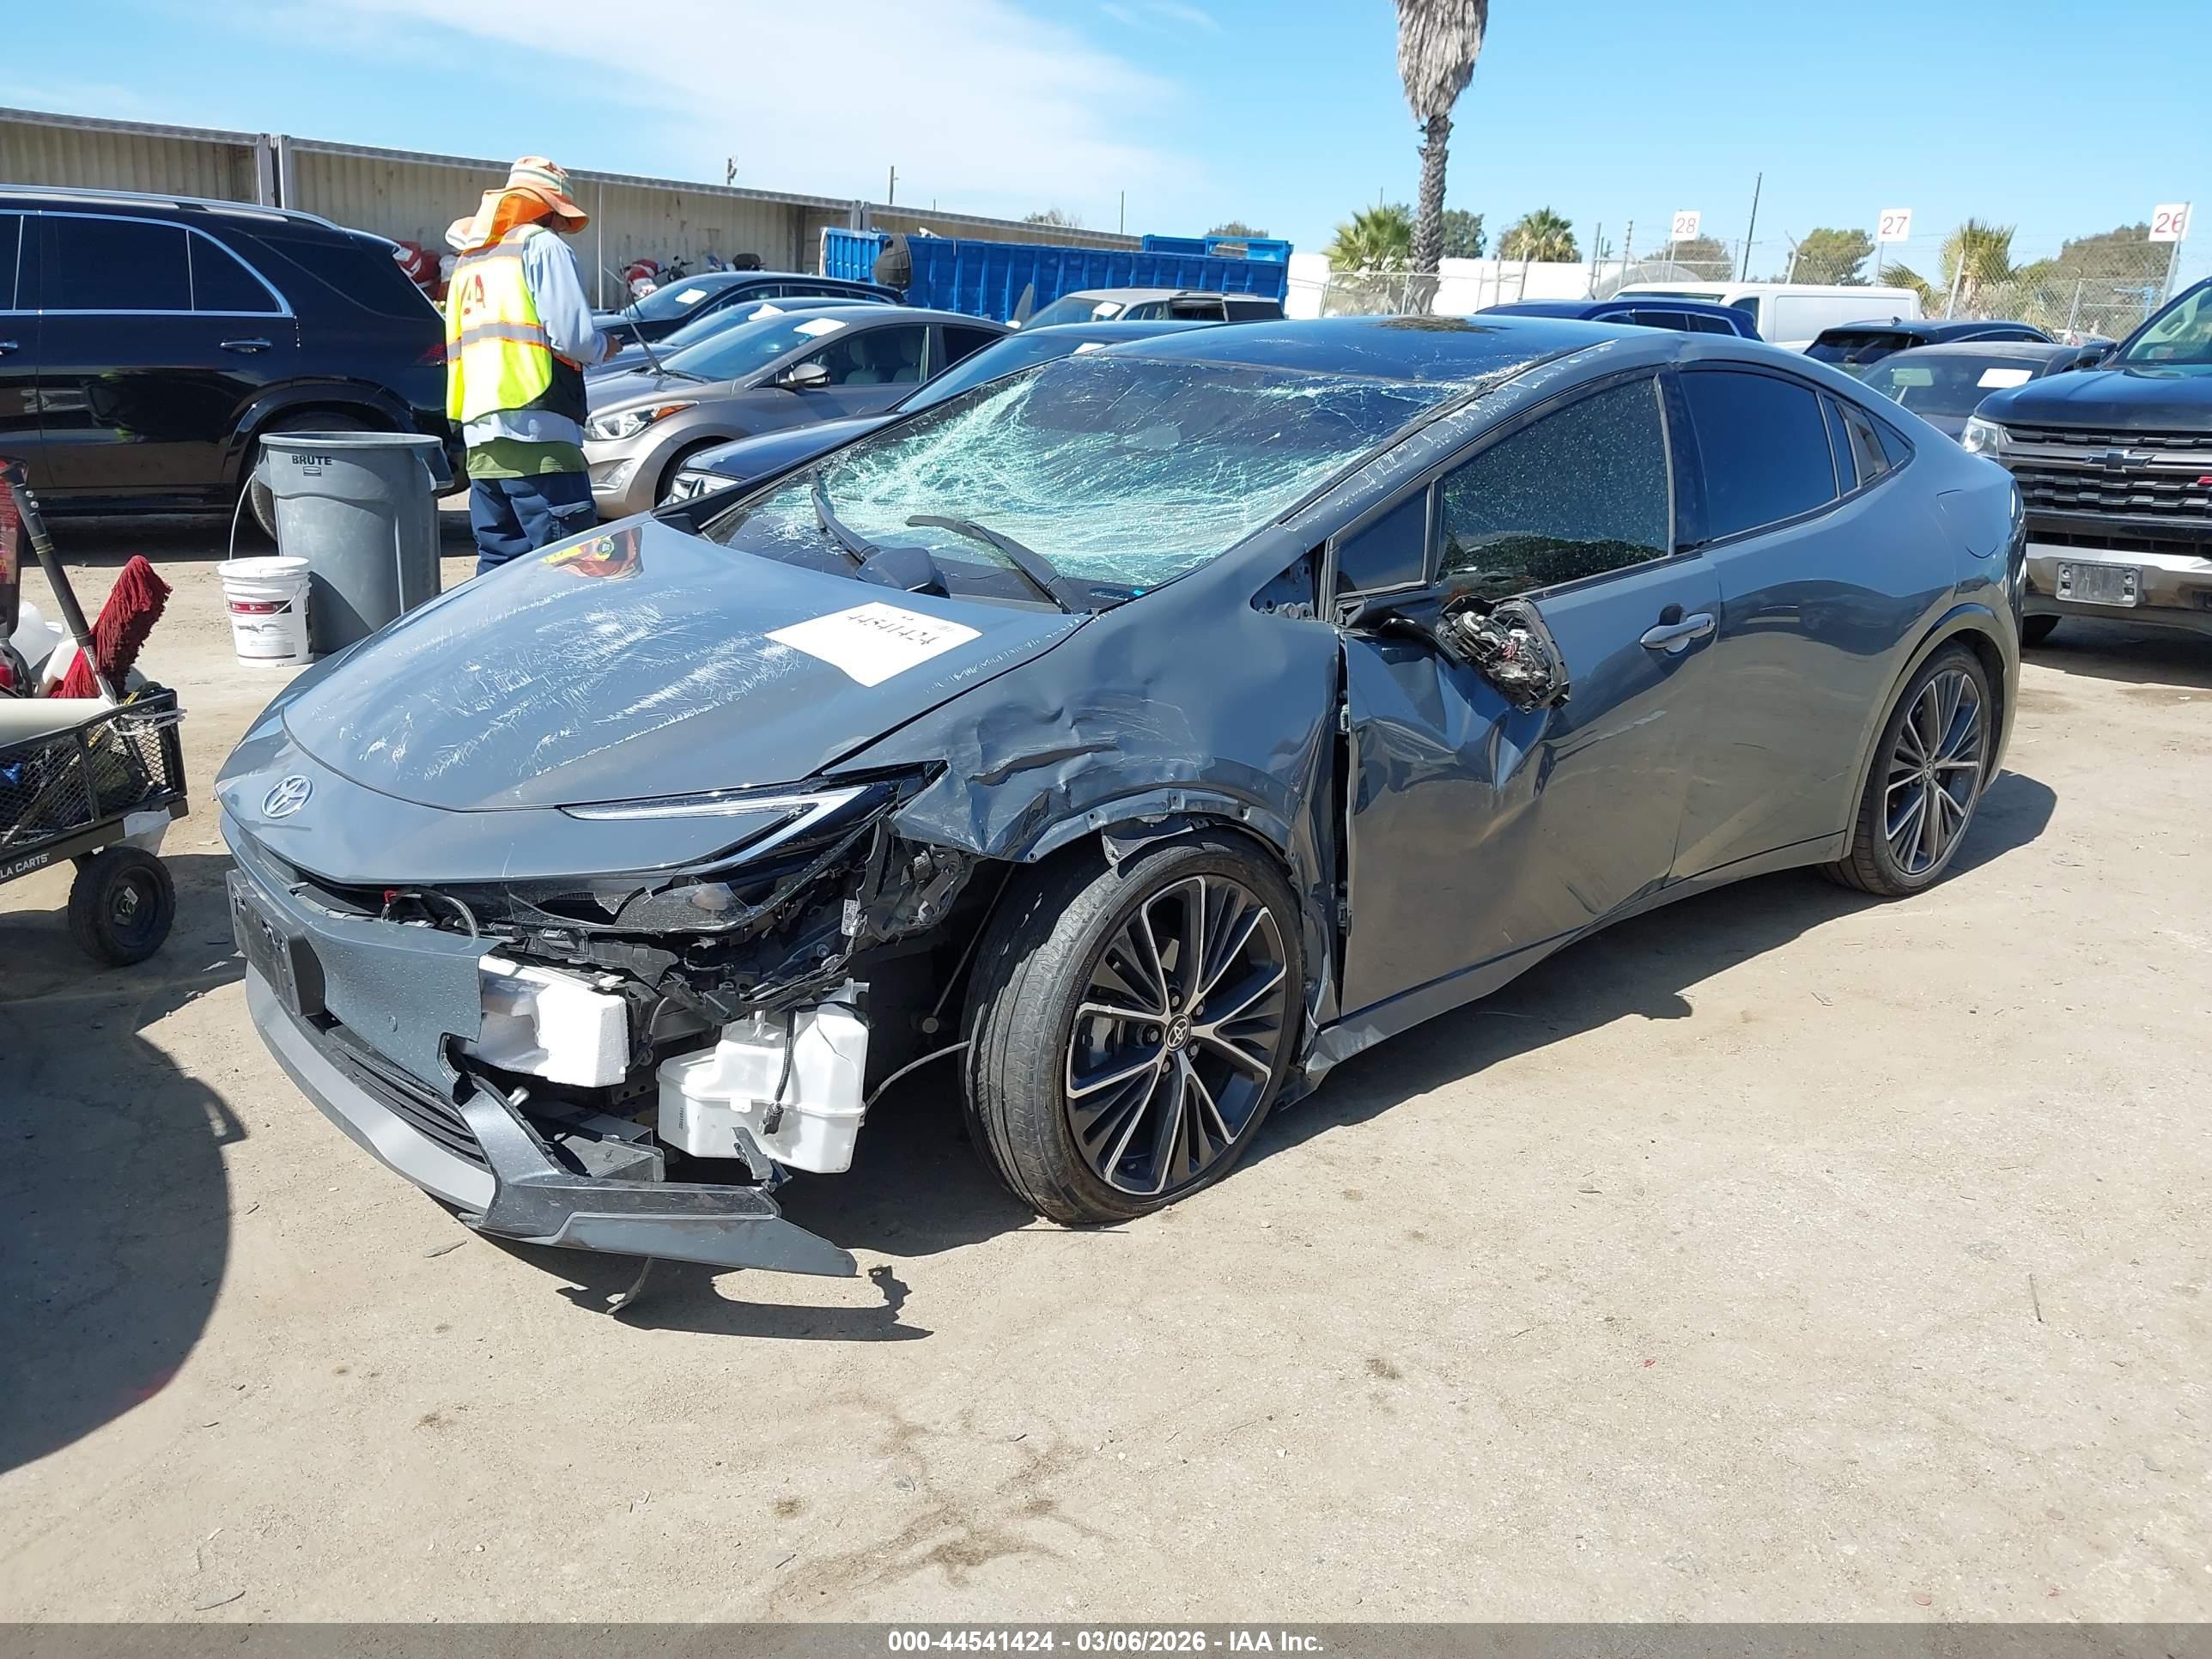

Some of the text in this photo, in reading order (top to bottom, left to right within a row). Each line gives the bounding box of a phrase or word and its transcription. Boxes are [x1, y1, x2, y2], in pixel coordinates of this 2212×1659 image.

[1675, 216, 1697, 234] 28
[1881, 216, 1908, 234] 27
[2154, 212, 2185, 234] 26
[292, 454, 333, 465] BRUTE
[15, 854, 48, 872] CARTS
